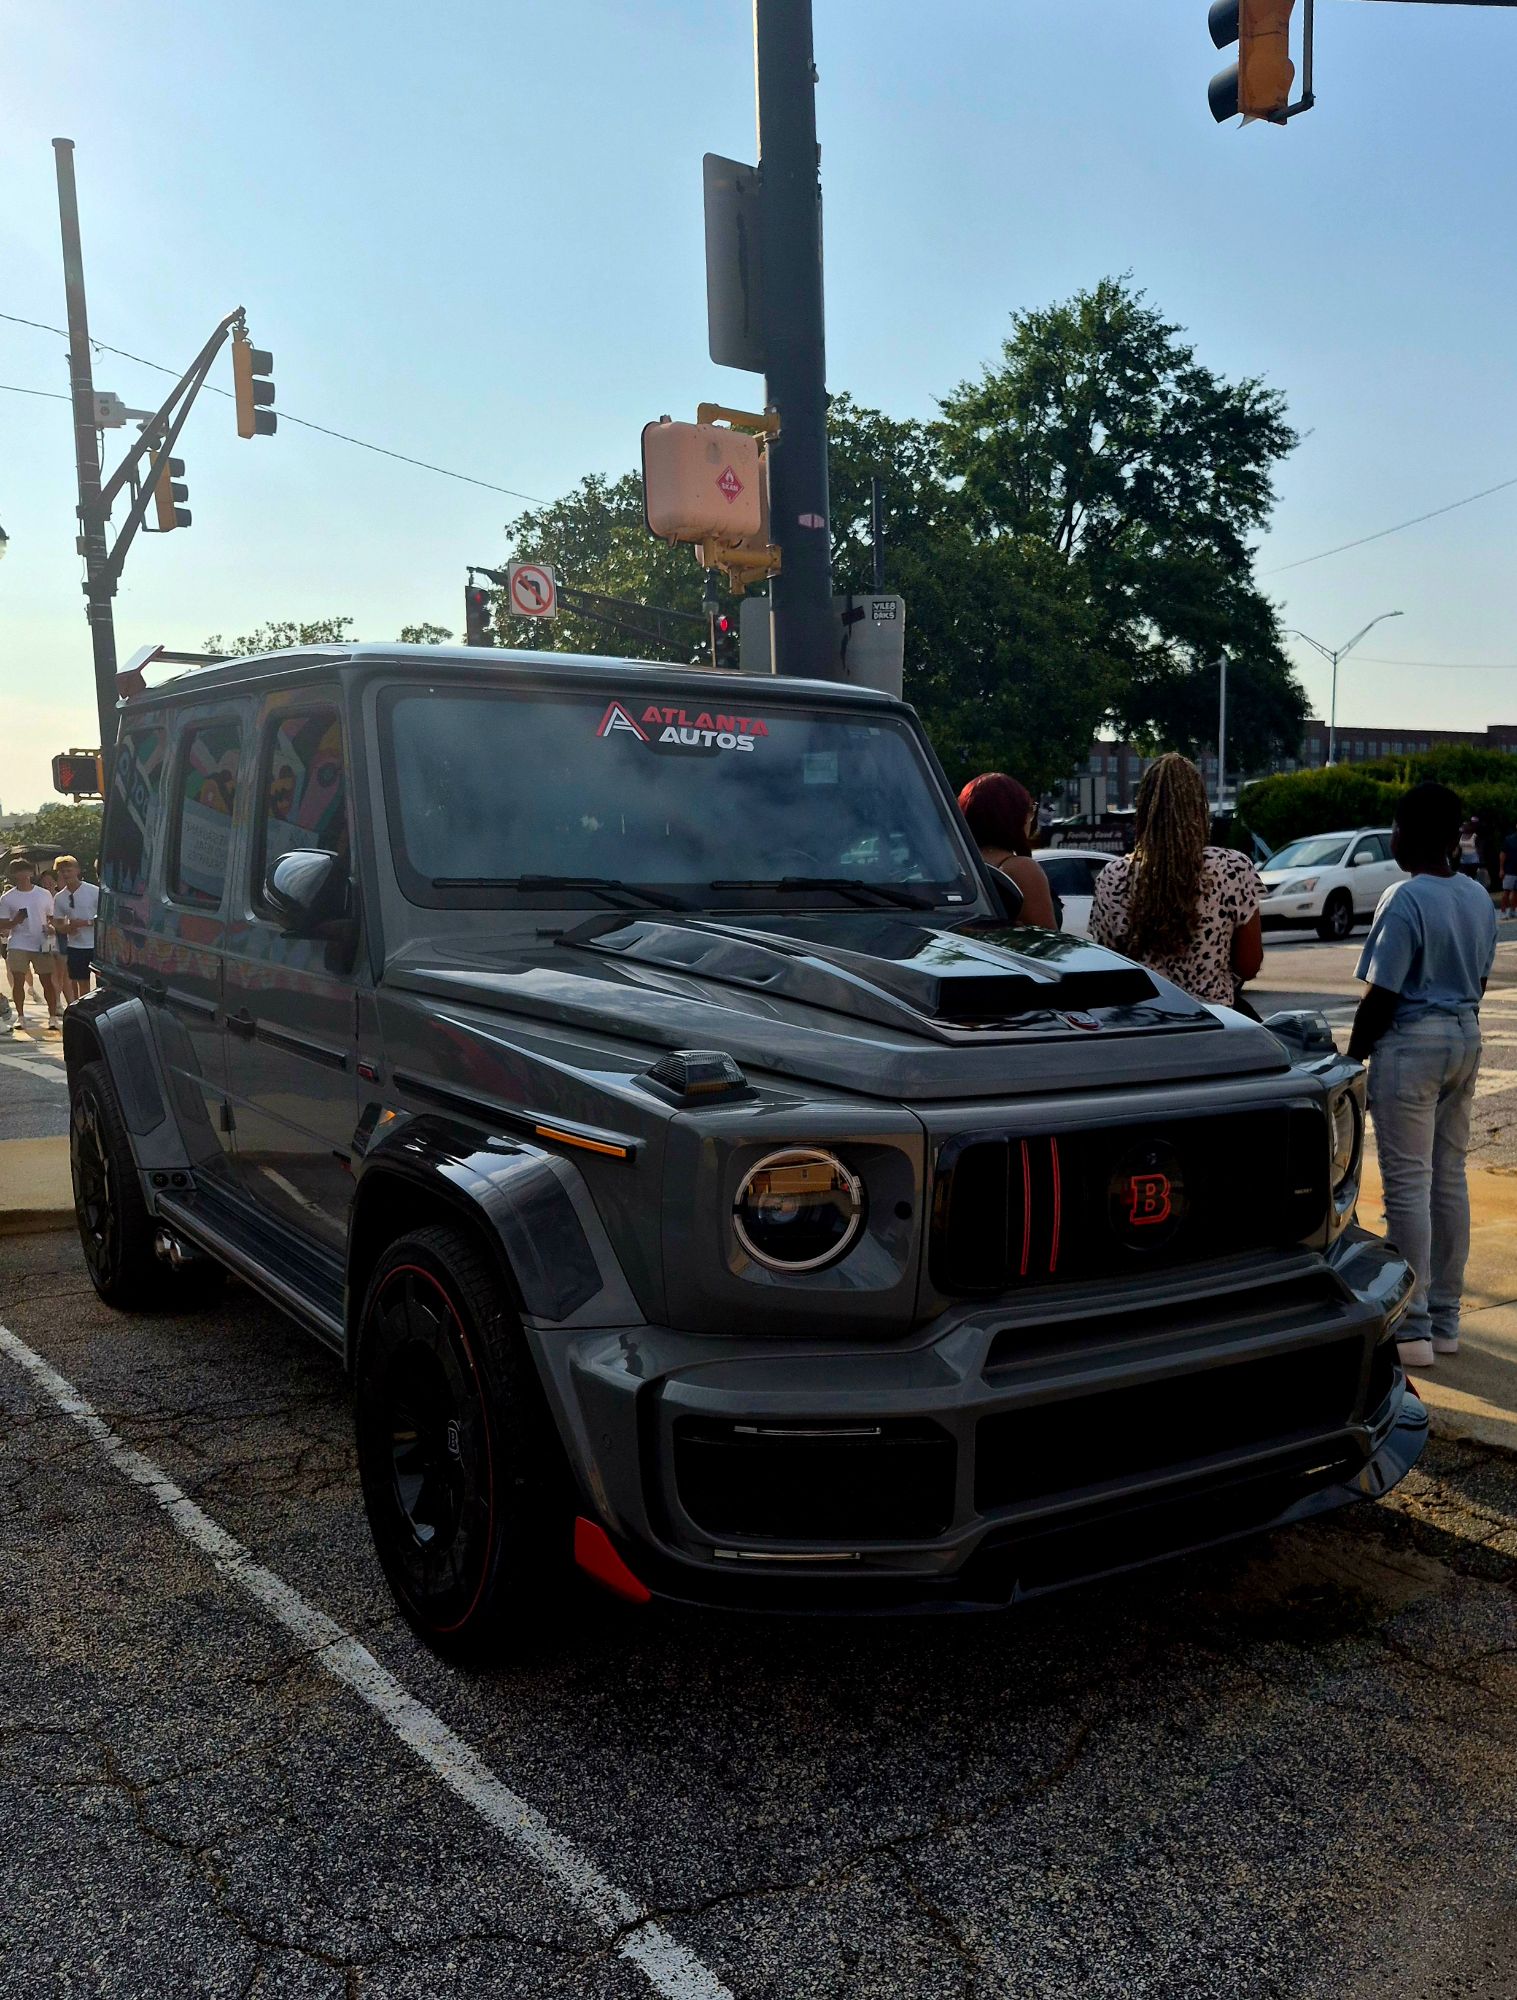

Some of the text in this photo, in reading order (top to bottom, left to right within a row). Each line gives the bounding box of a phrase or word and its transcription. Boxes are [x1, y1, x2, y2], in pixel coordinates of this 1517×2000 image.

[641, 705, 769, 737] ATLANTA
[658, 726, 755, 753] AUTOS
[1129, 1173, 1172, 1226] B
